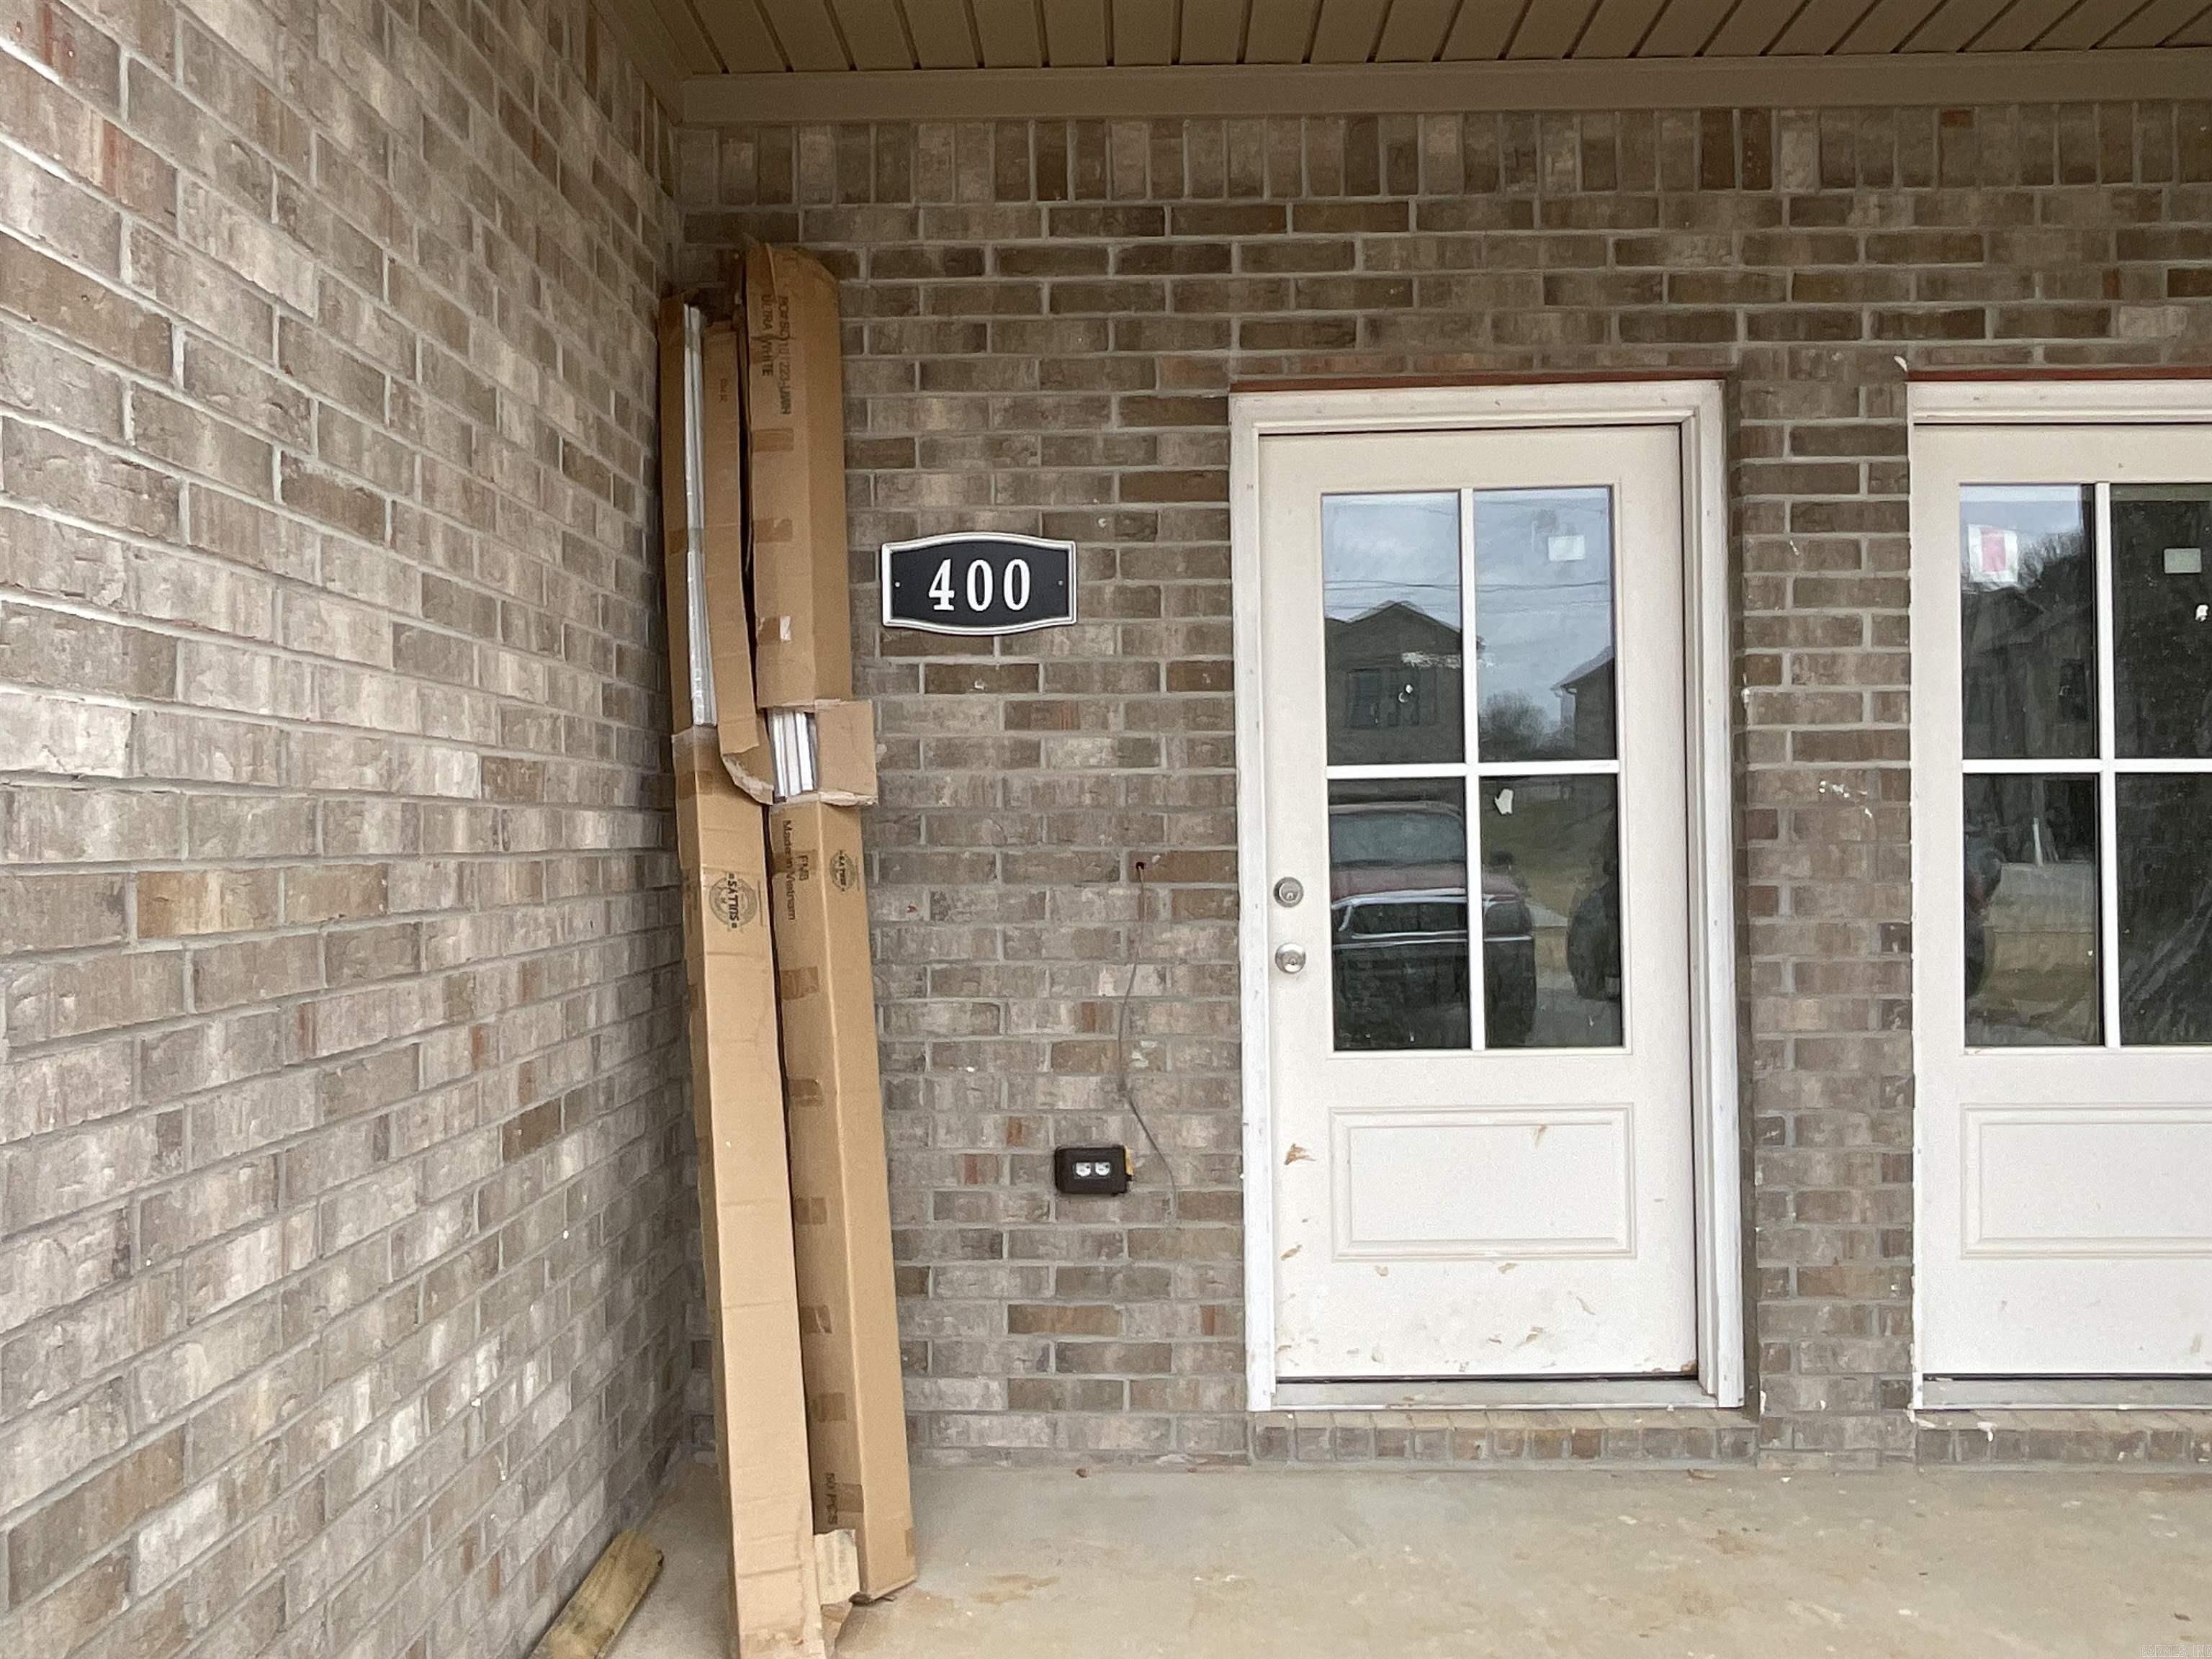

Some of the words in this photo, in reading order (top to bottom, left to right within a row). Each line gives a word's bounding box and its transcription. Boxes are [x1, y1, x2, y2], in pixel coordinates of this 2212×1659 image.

[761, 295, 773, 331] ULTRA
[761, 339, 773, 377] WHITE
[928, 558, 1031, 612] 400
[782, 819, 793, 854] Made
[786, 857, 796, 869] in
[785, 871, 796, 922] Vietnam
[826, 1493, 839, 1525] PCS
